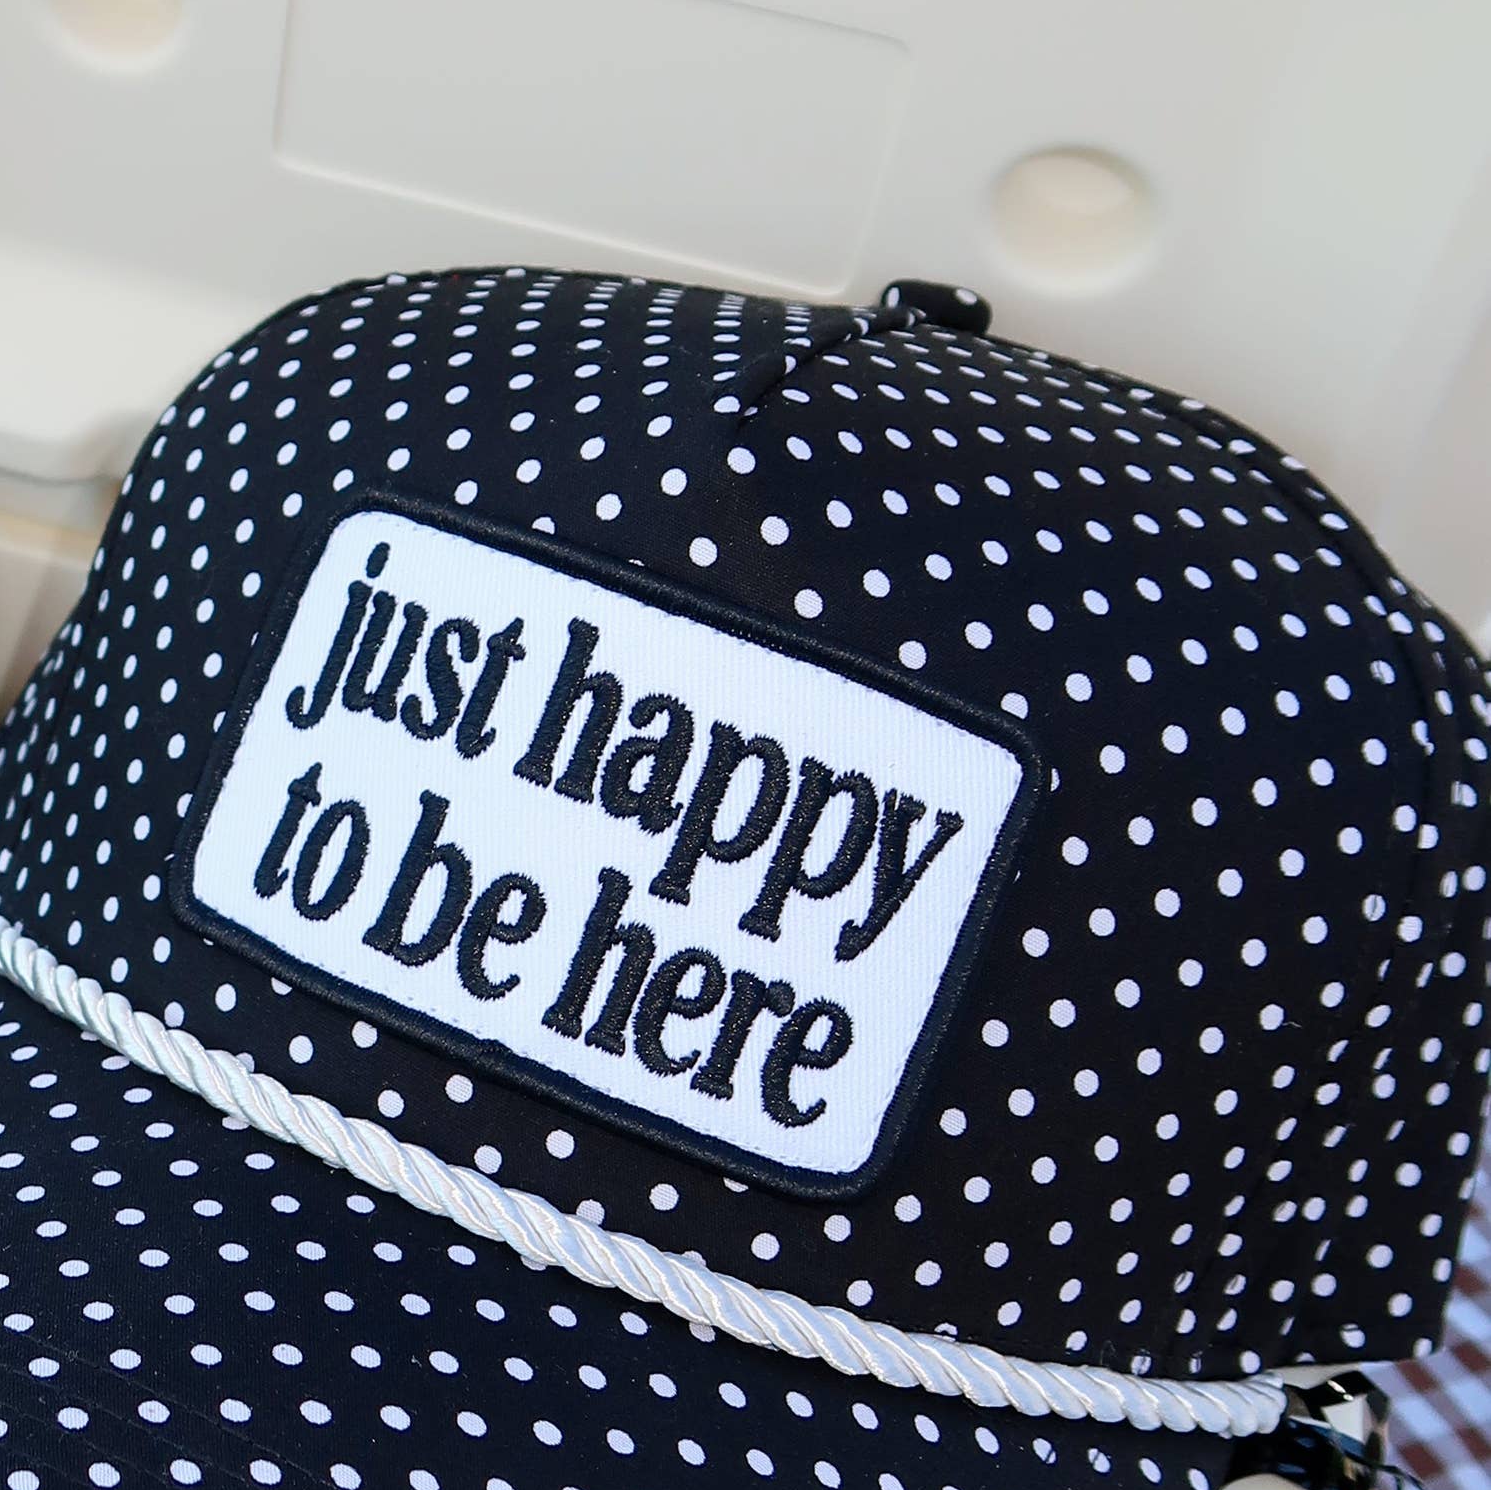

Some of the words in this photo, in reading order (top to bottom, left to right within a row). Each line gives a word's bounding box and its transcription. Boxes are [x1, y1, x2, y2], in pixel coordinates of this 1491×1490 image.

[254, 762, 370, 921] to
[362, 791, 547, 1000] be
[541, 866, 853, 1128] here
[285, 542, 526, 759] just
[513, 618, 964, 962] happy
